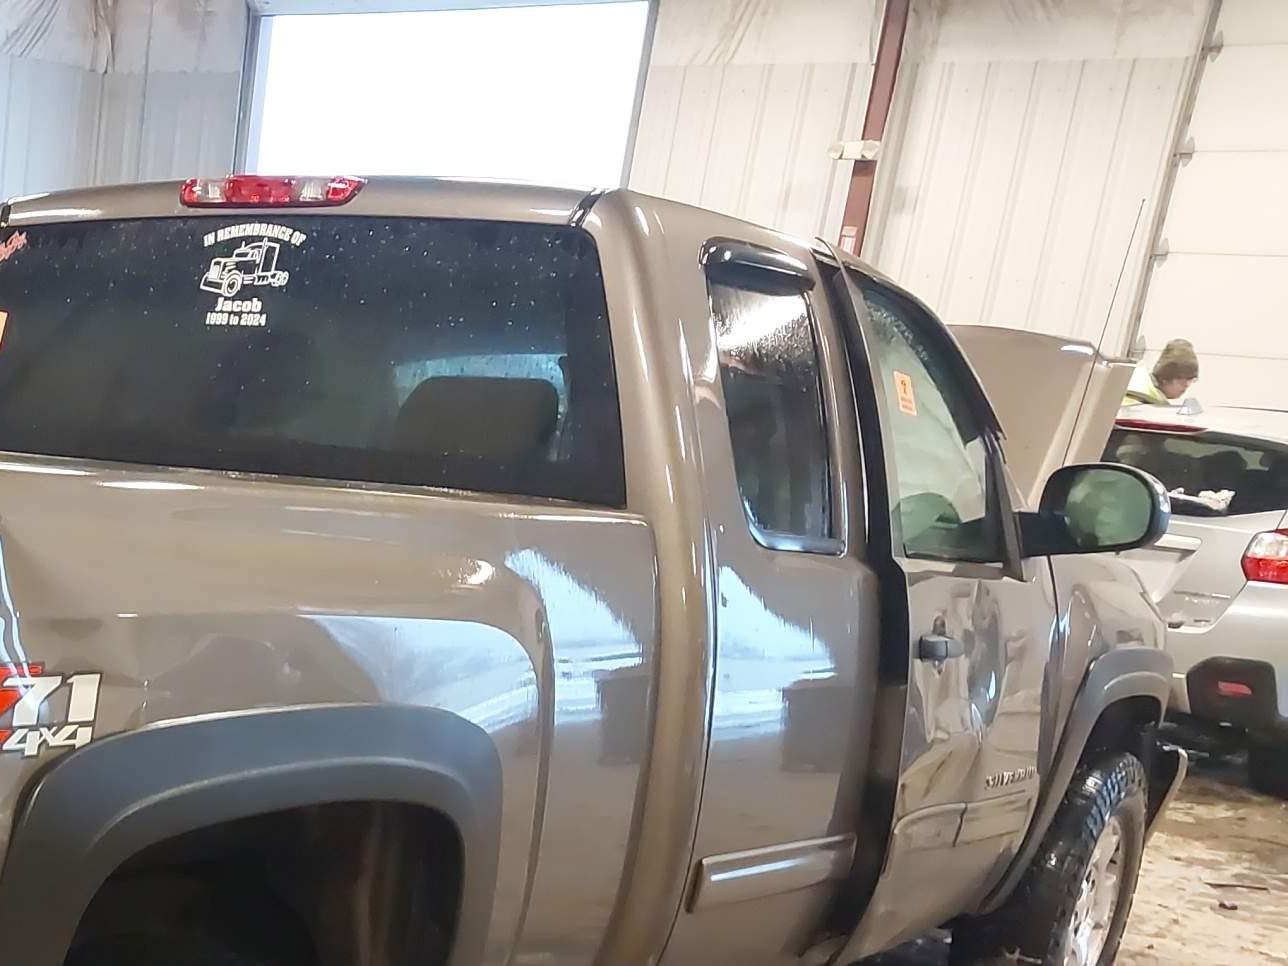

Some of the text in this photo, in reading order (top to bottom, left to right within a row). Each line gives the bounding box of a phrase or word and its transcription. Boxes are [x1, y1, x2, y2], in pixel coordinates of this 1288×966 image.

[203, 223, 307, 247] IN REMEMBRANCE OF
[215, 297, 262, 312] Jacob
[205, 312, 267, 326] 1999 to 2024
